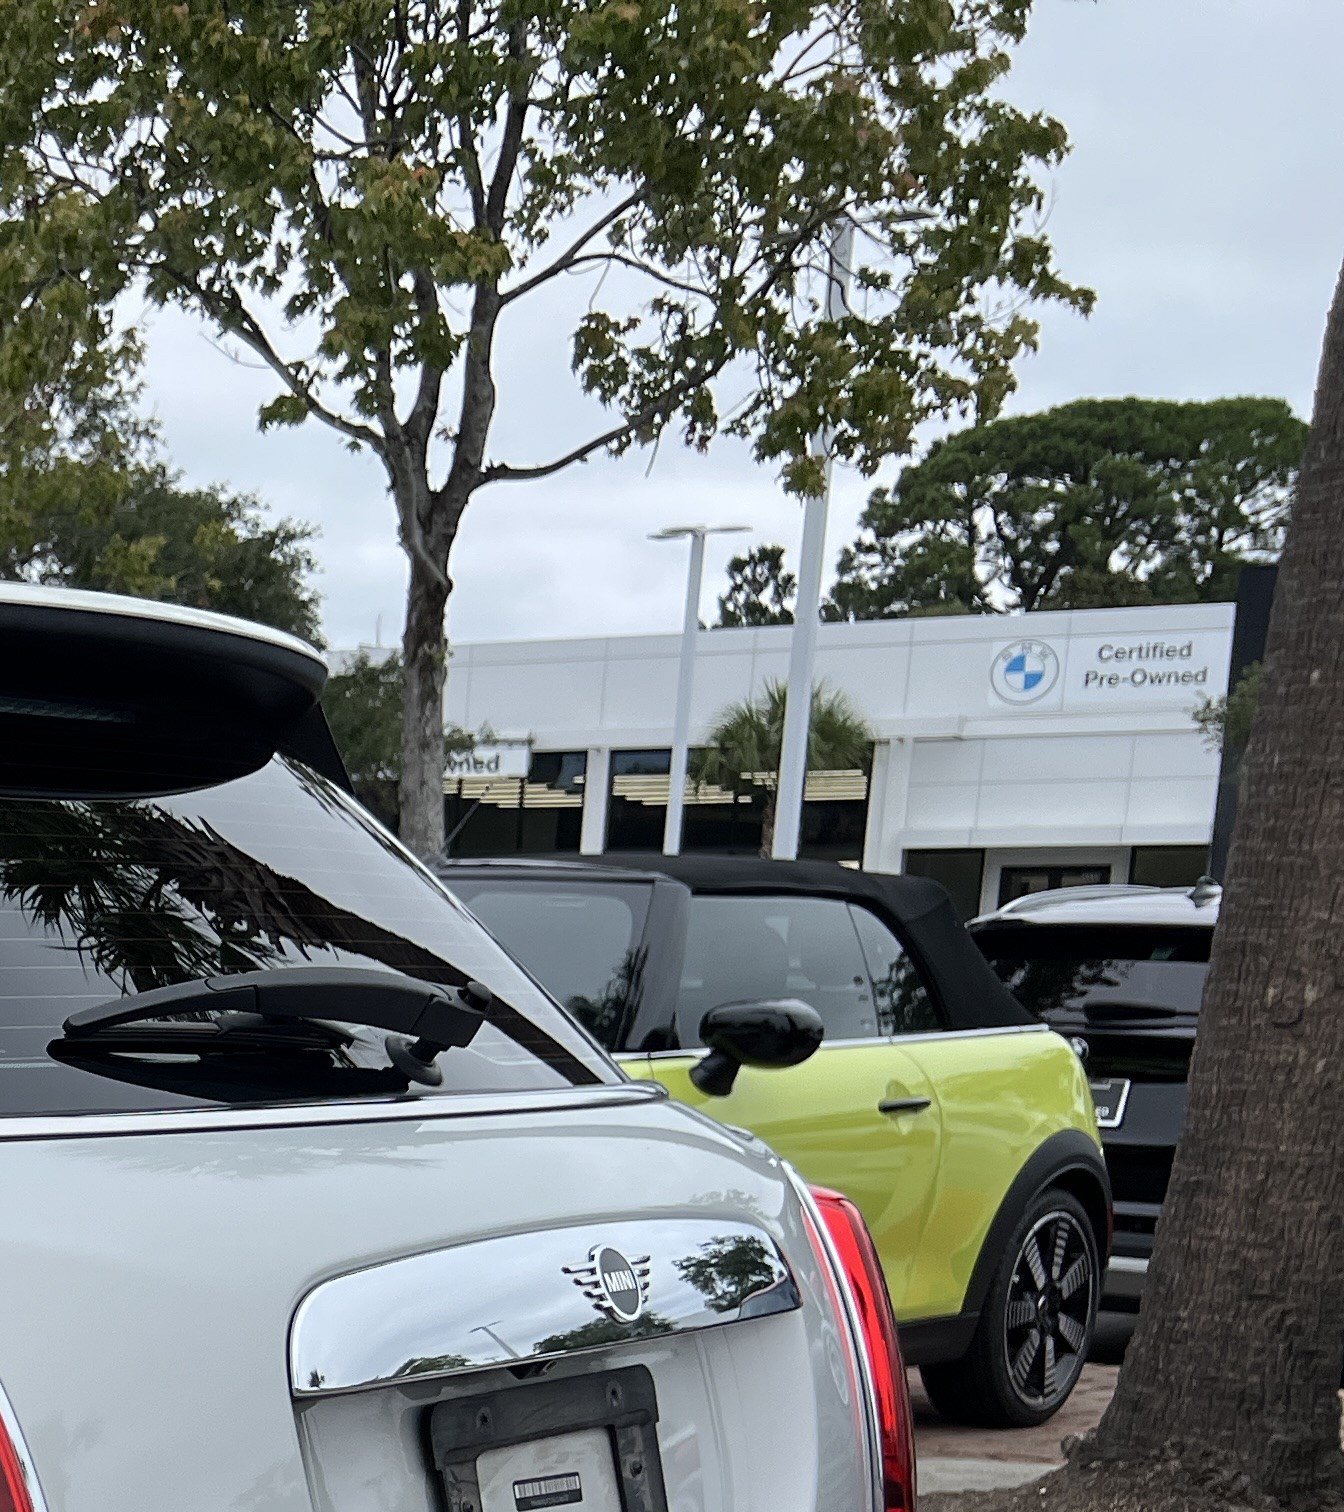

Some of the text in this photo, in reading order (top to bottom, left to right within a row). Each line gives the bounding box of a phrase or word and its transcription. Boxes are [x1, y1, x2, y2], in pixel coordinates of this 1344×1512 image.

[1097, 641, 1193, 663] Certified
[1084, 668, 1208, 688] Pre-Owned
[603, 1269, 637, 1293] MINI
